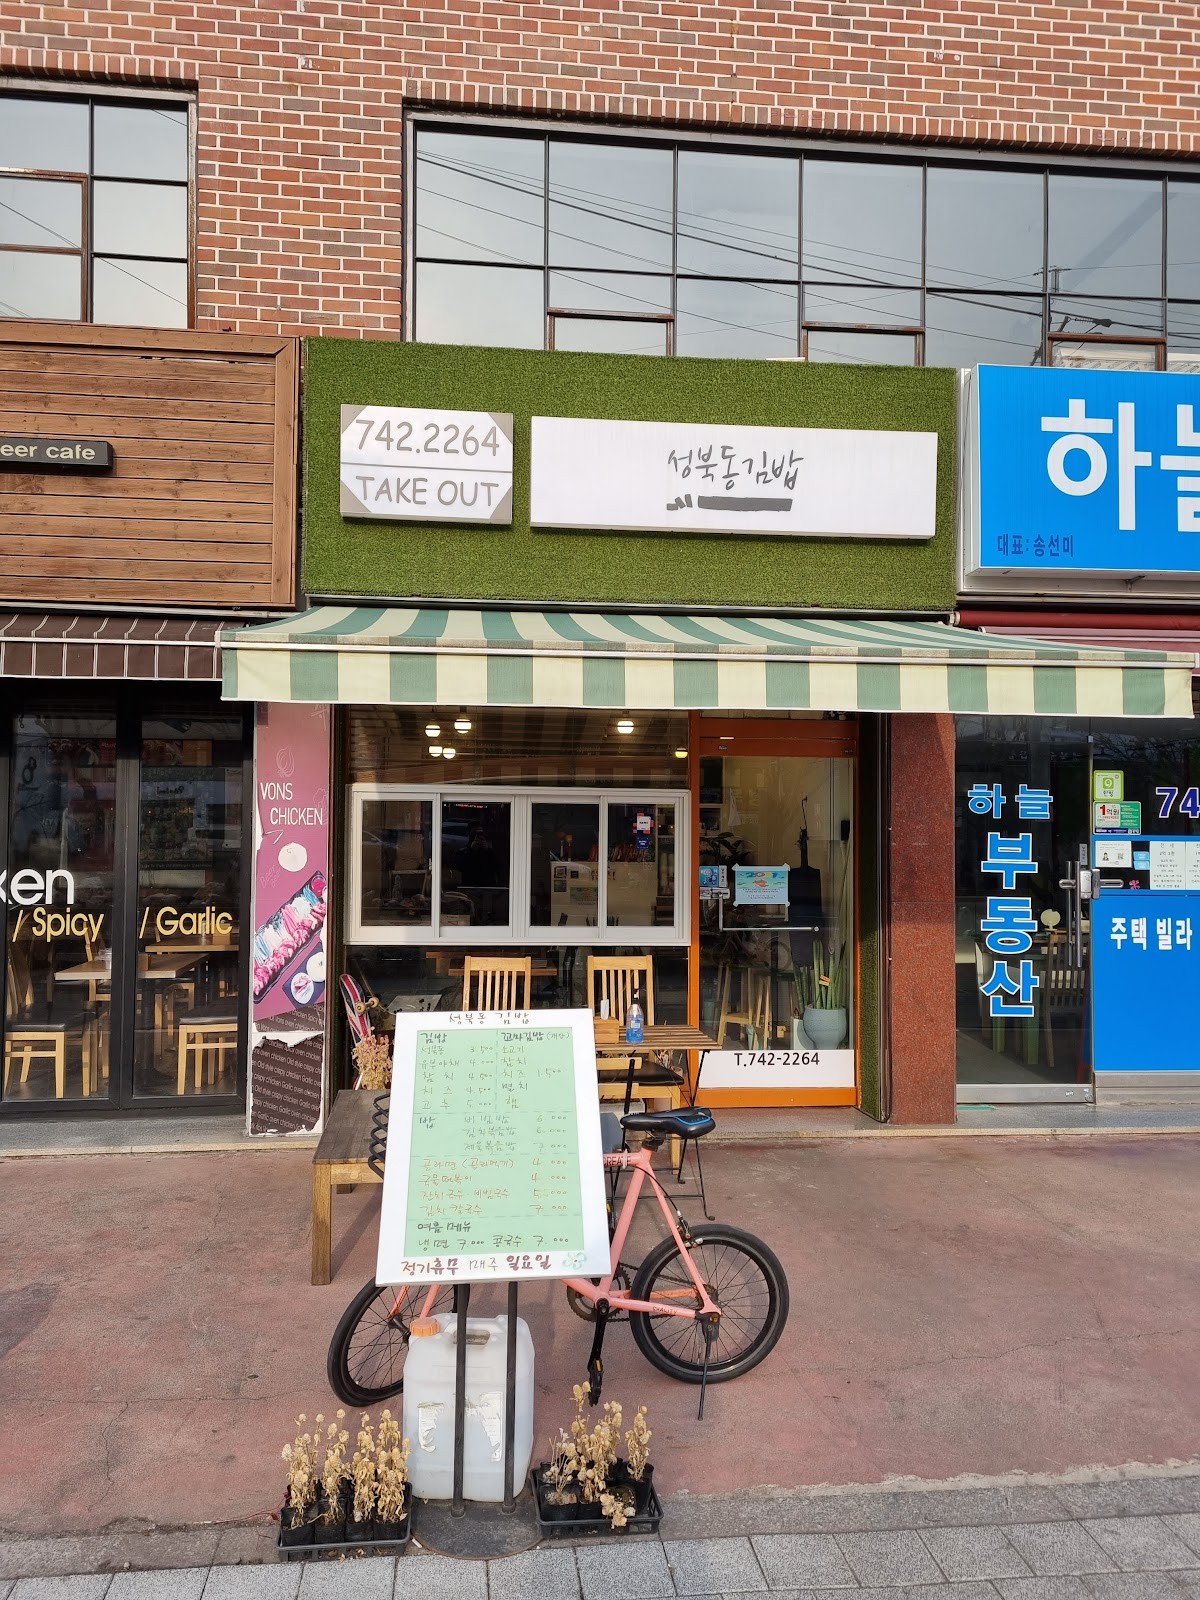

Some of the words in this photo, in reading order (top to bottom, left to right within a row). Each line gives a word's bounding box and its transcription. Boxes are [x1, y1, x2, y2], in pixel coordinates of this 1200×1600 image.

[0, 444, 38, 457] eer
[46, 445, 96, 460] cafe
[356, 420, 499, 456] 742.2264
[668, 444, 804, 490] 성북동김밥
[356, 476, 428, 505] TAKE
[438, 480, 499, 506] OUT
[260, 782, 293, 800] VONS
[270, 807, 323, 825] CHICKEN
[32, 907, 104, 942] Spicy
[156, 906, 233, 936] Garlic
[980, 832, 1040, 1017] 부동산
[1110, 918, 1147, 950] 주택
[1156, 918, 1193, 950] 빌라
[734, 1052, 820, 1067] T.742-2264
[506, 1255, 551, 1271] 일요일
